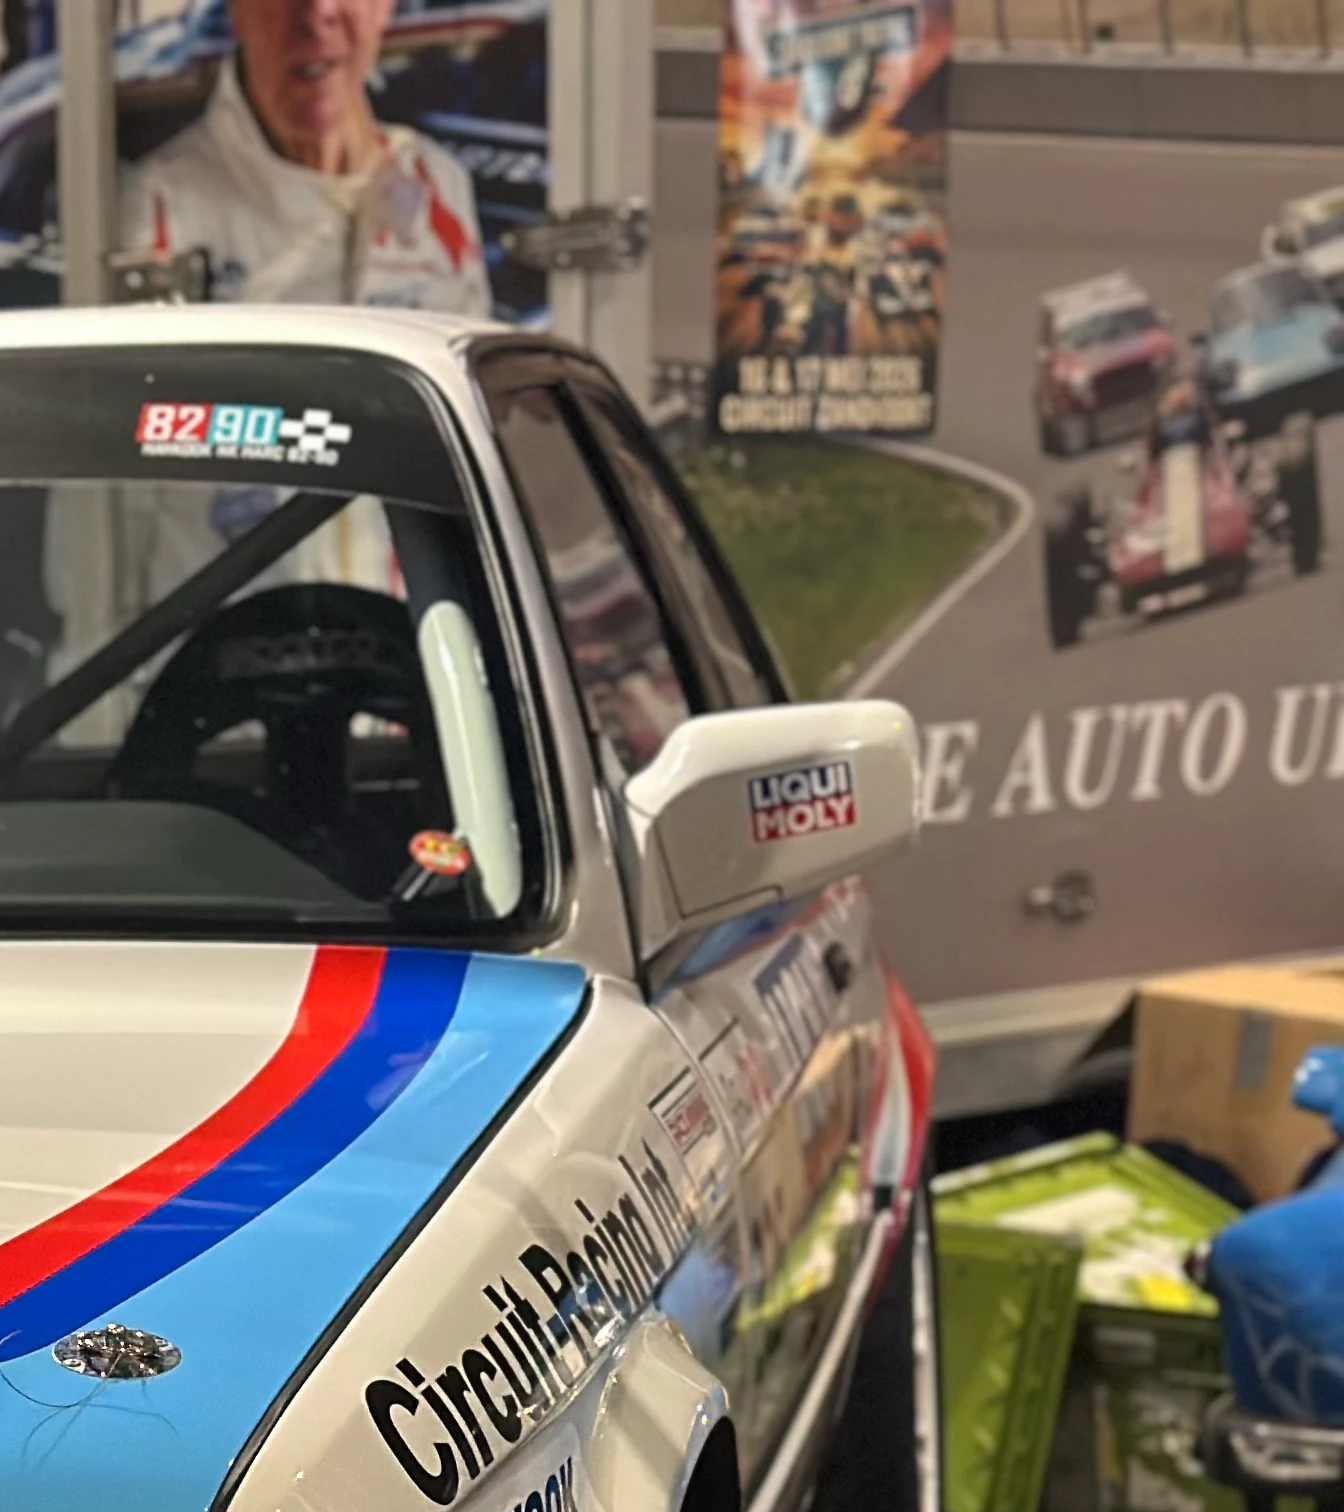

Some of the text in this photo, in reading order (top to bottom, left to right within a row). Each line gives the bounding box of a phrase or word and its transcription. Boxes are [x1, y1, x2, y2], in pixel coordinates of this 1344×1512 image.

[990, 691, 1248, 818] AUTO
[1268, 680, 1344, 787] U
[752, 763, 849, 809] LIQUI
[755, 794, 852, 841] MOLY
